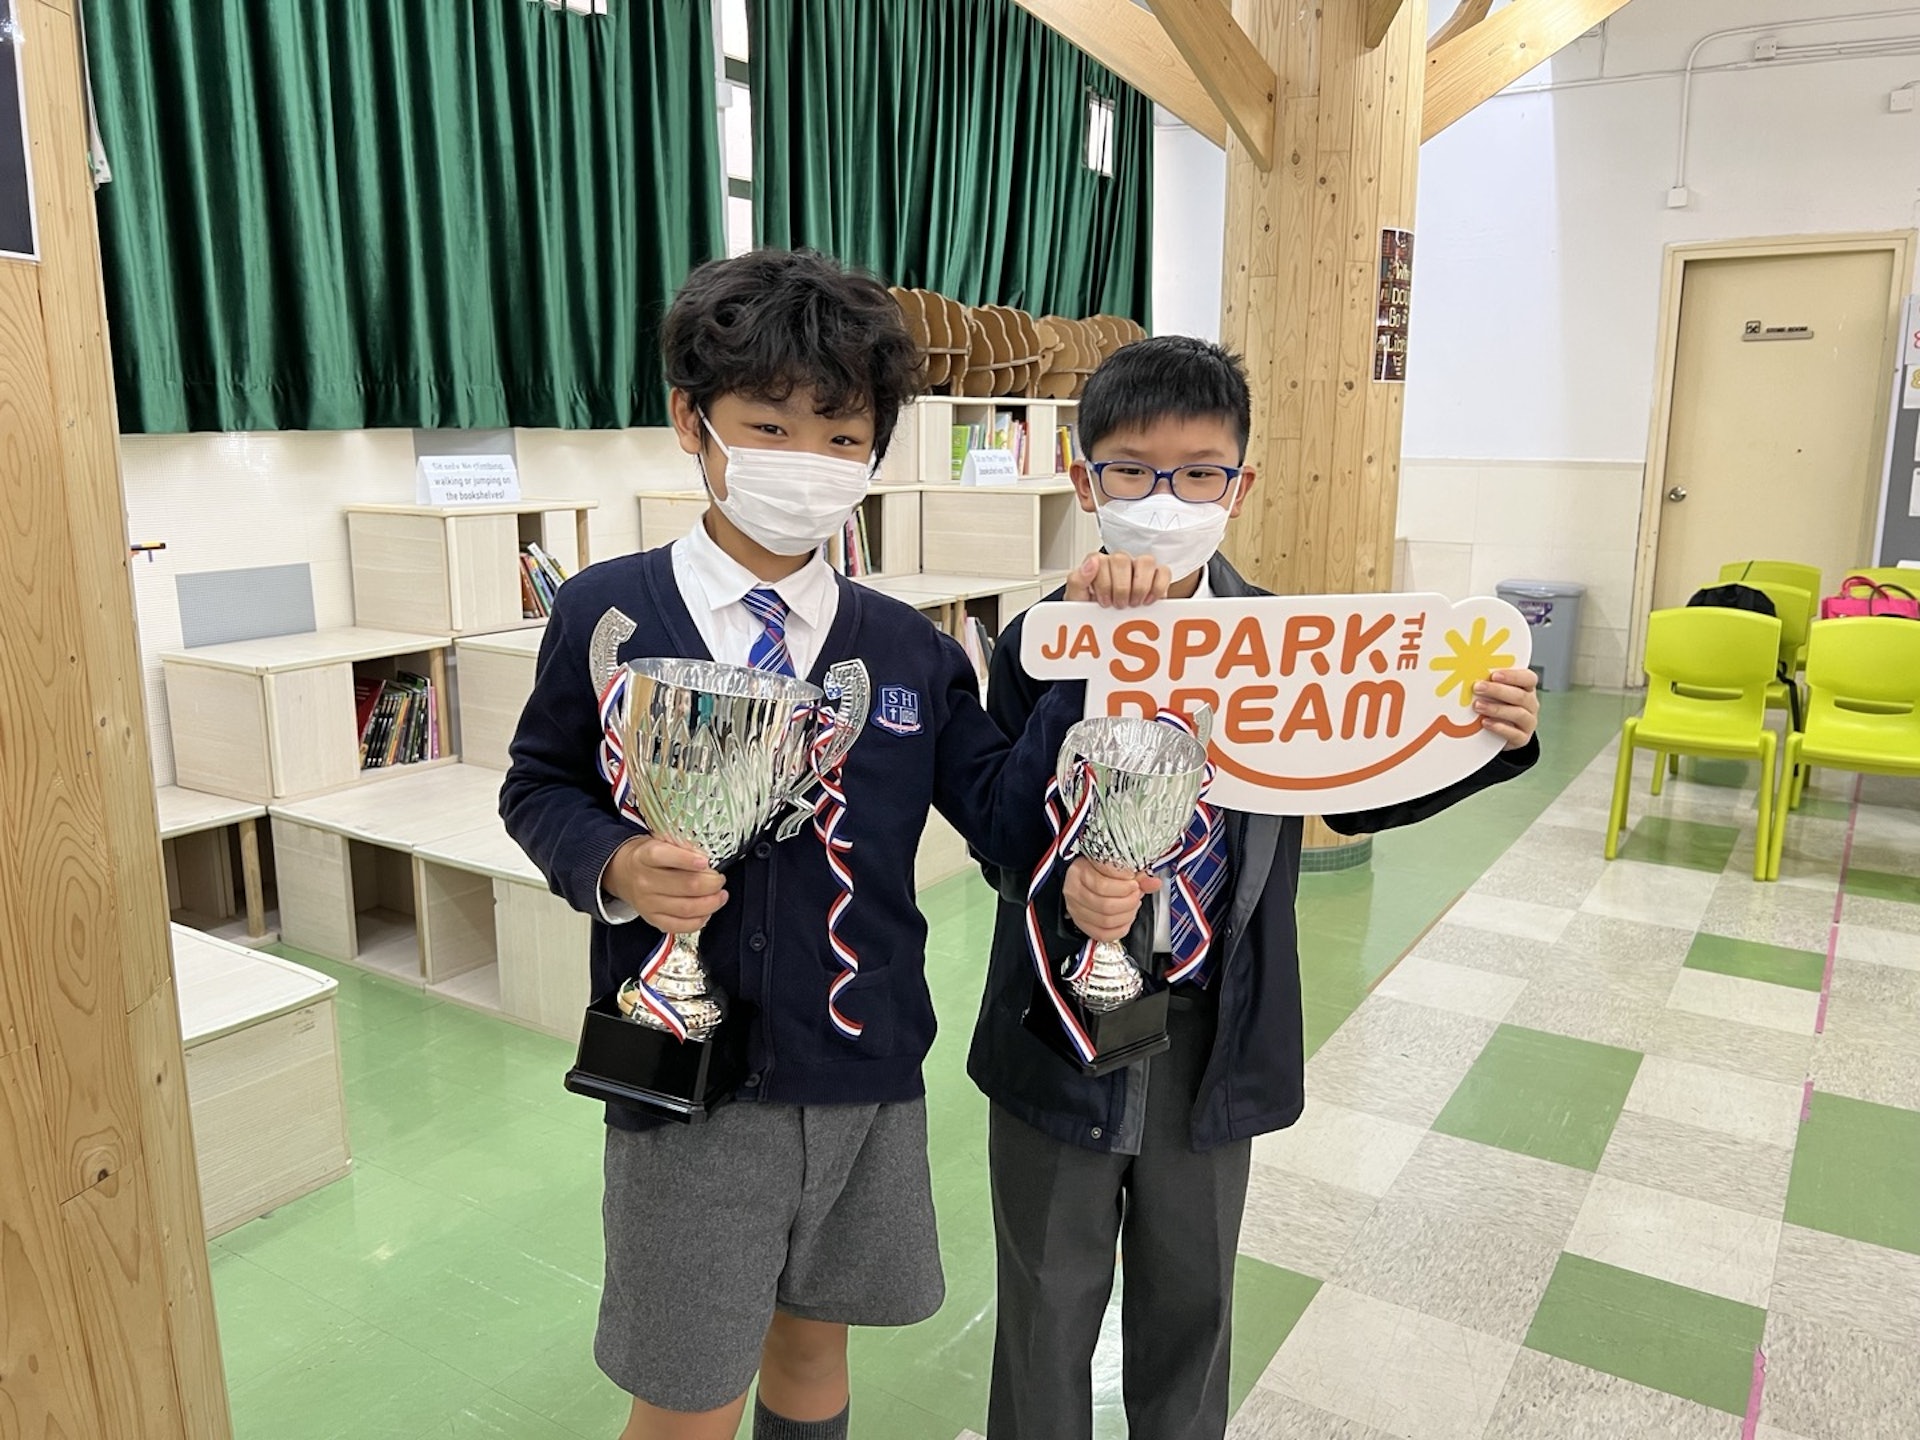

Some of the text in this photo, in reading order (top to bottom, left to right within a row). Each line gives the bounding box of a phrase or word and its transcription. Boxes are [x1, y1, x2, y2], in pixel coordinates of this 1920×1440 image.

[434, 475, 512, 487] walking or jumping on
[446, 491, 458, 500] the
[1041, 613, 1396, 682] JA SPARK
[1396, 612, 1426, 671] THE
[888, 691, 913, 707] SH
